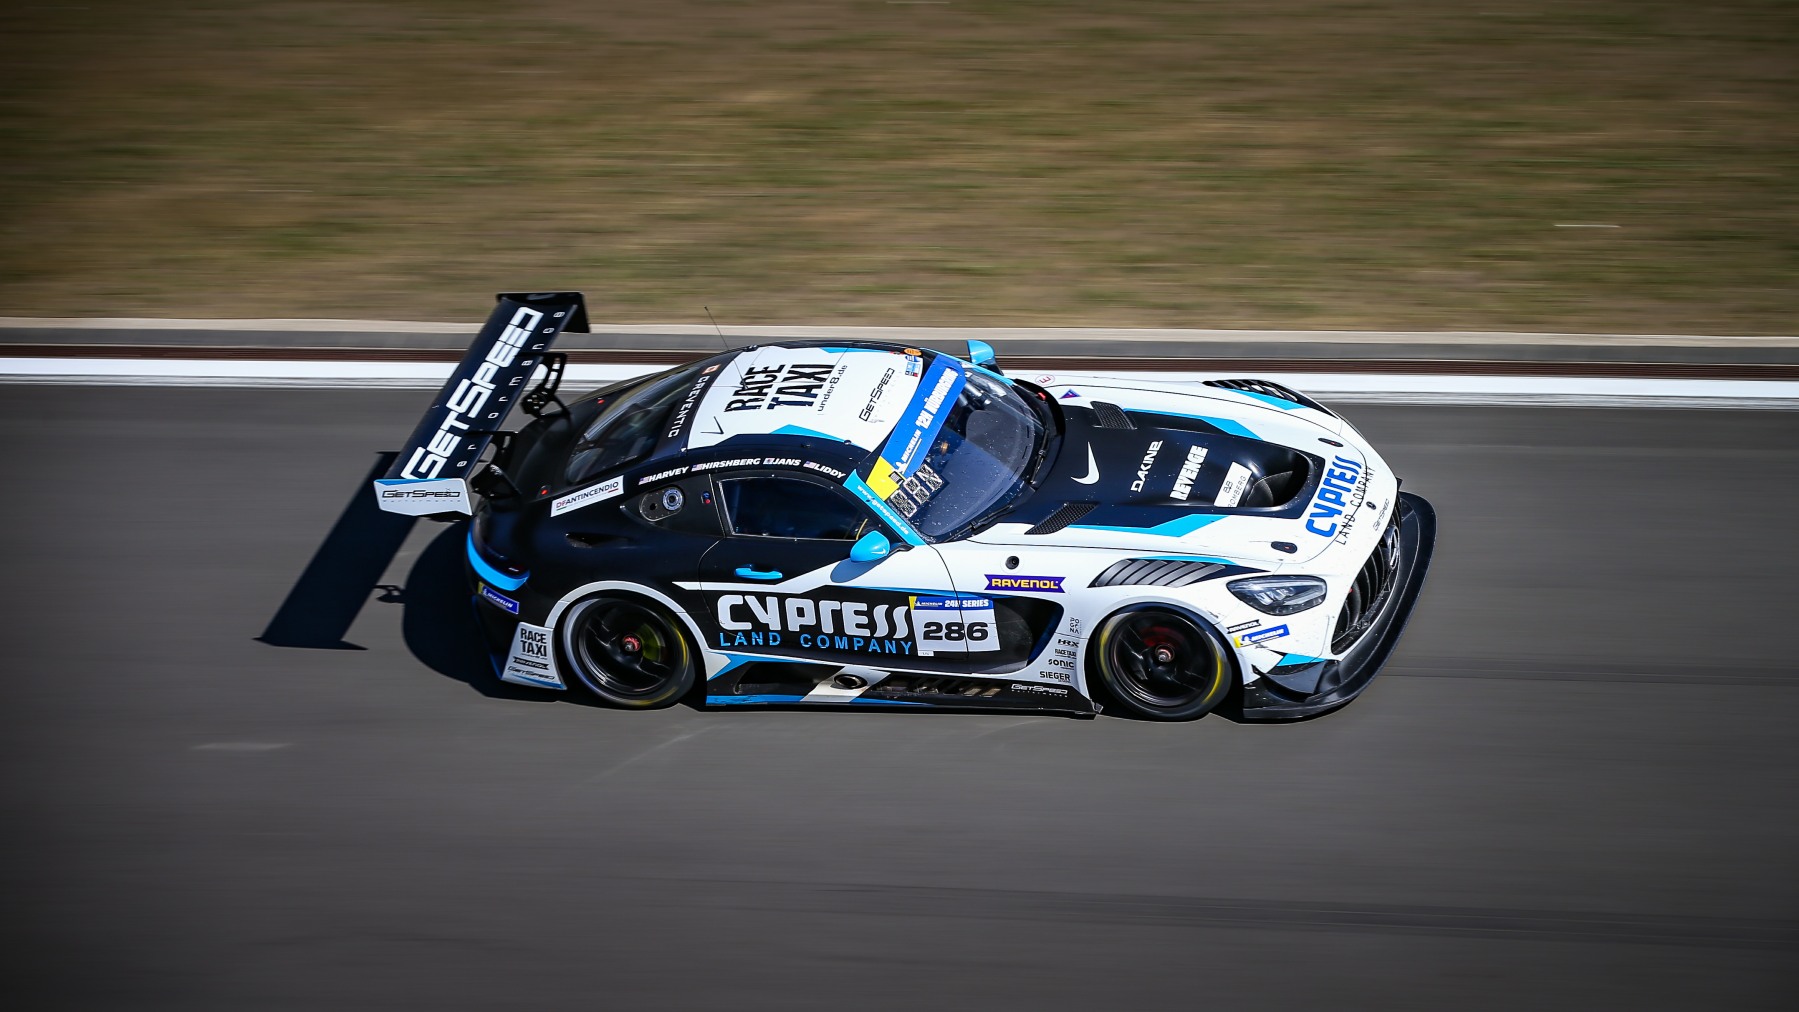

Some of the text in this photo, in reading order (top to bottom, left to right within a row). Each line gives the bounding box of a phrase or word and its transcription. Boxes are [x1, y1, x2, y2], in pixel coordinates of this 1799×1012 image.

[724, 364, 786, 412] RACE
[767, 364, 836, 410] TAXI
[667, 375, 711, 438] CREVENTIC
[915, 409, 934, 430] 12H
[900, 429, 922, 463] MICHELIN
[648, 457, 846, 482] HARVEY HIRSHBERG JANS LIDDY
[1130, 440, 1164, 493] DAKINE
[1169, 445, 1209, 501] REVENGE
[1335, 466, 1376, 546] LAND COMPANY
[991, 578, 1059, 589] RAVENOL
[961, 598, 989, 608] SERIES
[520, 628, 547, 644] RACE
[719, 631, 913, 655] LAND COMPANY
[923, 621, 989, 641] 286
[1058, 638, 1079, 648] HRX
[520, 640, 547, 657] TAXI
[1039, 671, 1071, 681] SIEGER
